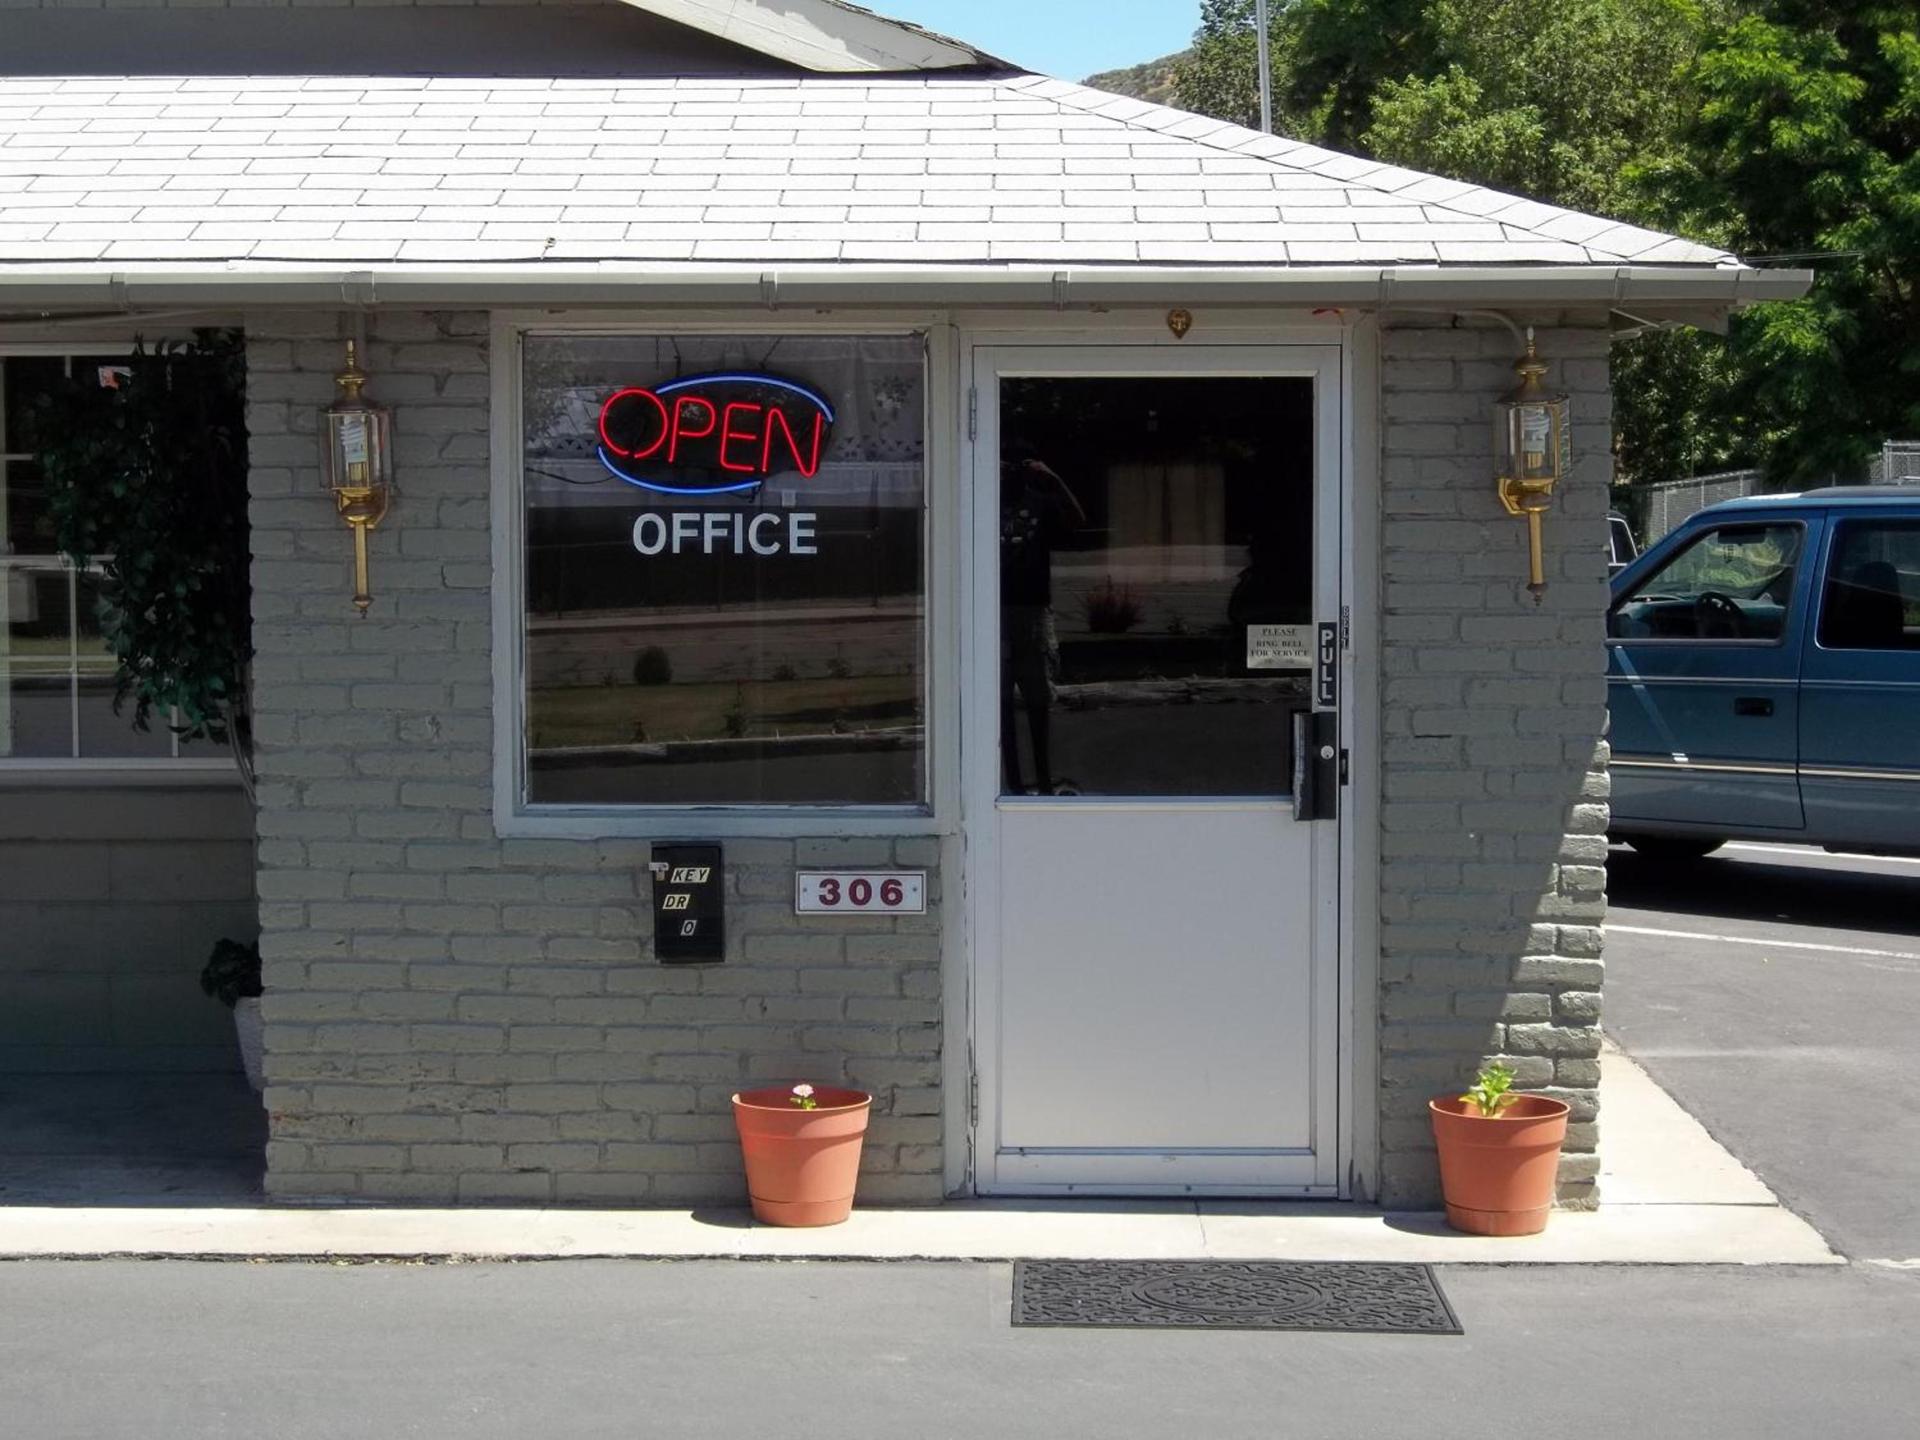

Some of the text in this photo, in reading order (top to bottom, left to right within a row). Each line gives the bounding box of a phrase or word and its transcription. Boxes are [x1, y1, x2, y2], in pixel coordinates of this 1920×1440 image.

[600, 387, 825, 478] OPEN
[632, 512, 818, 556] OFFICE
[1262, 627, 1297, 637] PLEASE
[1256, 640, 1304, 648] RING BELL
[1250, 649, 1309, 657] FOR SERVICE
[1321, 629, 1334, 700] PULL
[674, 868, 708, 881] KEY
[818, 878, 904, 906] 306
[665, 895, 687, 908] DR
